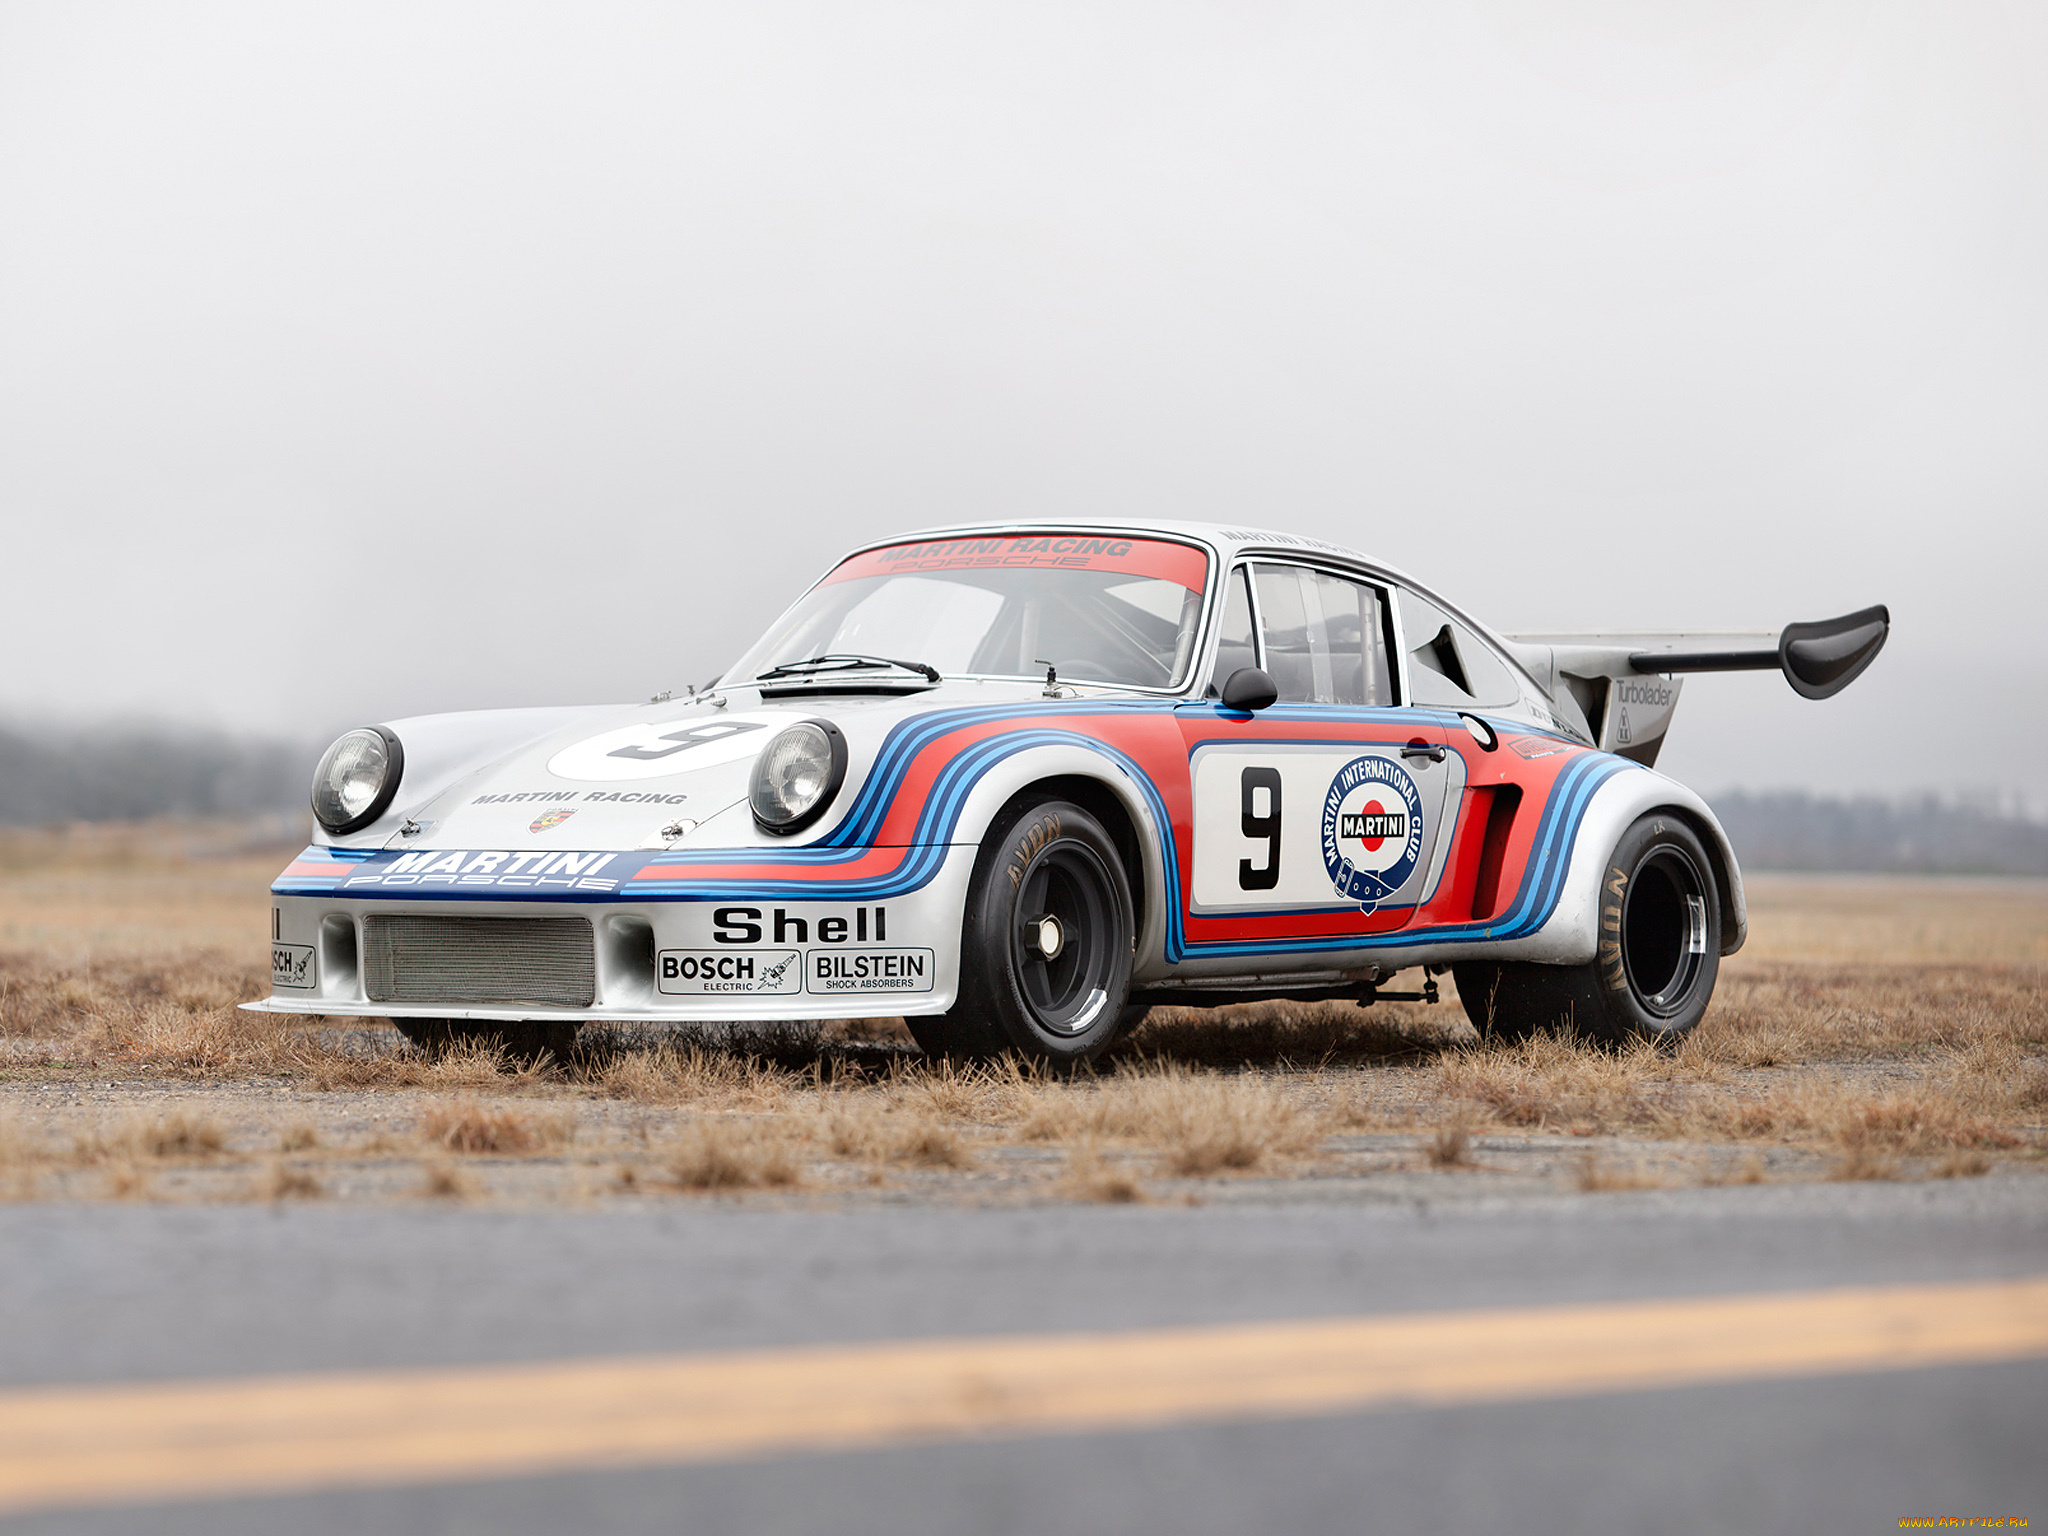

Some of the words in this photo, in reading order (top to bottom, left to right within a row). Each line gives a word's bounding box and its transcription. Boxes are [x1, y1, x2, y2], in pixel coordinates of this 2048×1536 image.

[1217, 530, 1299, 545] MARTINI
[878, 538, 1007, 563] MARTINI
[1008, 537, 1133, 558] RACING
[890, 556, 1091, 572] PORSCHE
[1616, 679, 1673, 706] Turbolader
[606, 721, 768, 760] 9
[471, 791, 579, 805] MARTINI
[583, 791, 688, 805] RACING
[1323, 785, 1343, 868] MARTINI
[1340, 759, 1418, 812] INTERNATIONAL
[1405, 815, 1422, 864] CLUB
[1238, 766, 1282, 891] 9
[1343, 816, 1403, 836] MARTINI
[1653, 819, 1666, 835] LR
[1006, 812, 1061, 889] AVON
[381, 851, 619, 876] MARTINI
[343, 875, 620, 891] PORSCHE
[713, 906, 886, 944] Shell
[1601, 866, 1630, 991] AVON
[272, 950, 292, 972] SCH
[662, 956, 755, 980] BOSCH
[816, 955, 924, 979] BILSTEIN
[703, 982, 753, 992] ELECTRIC
[825, 980, 857, 989] SHOCK
[860, 978, 914, 988] ABSORBERS
